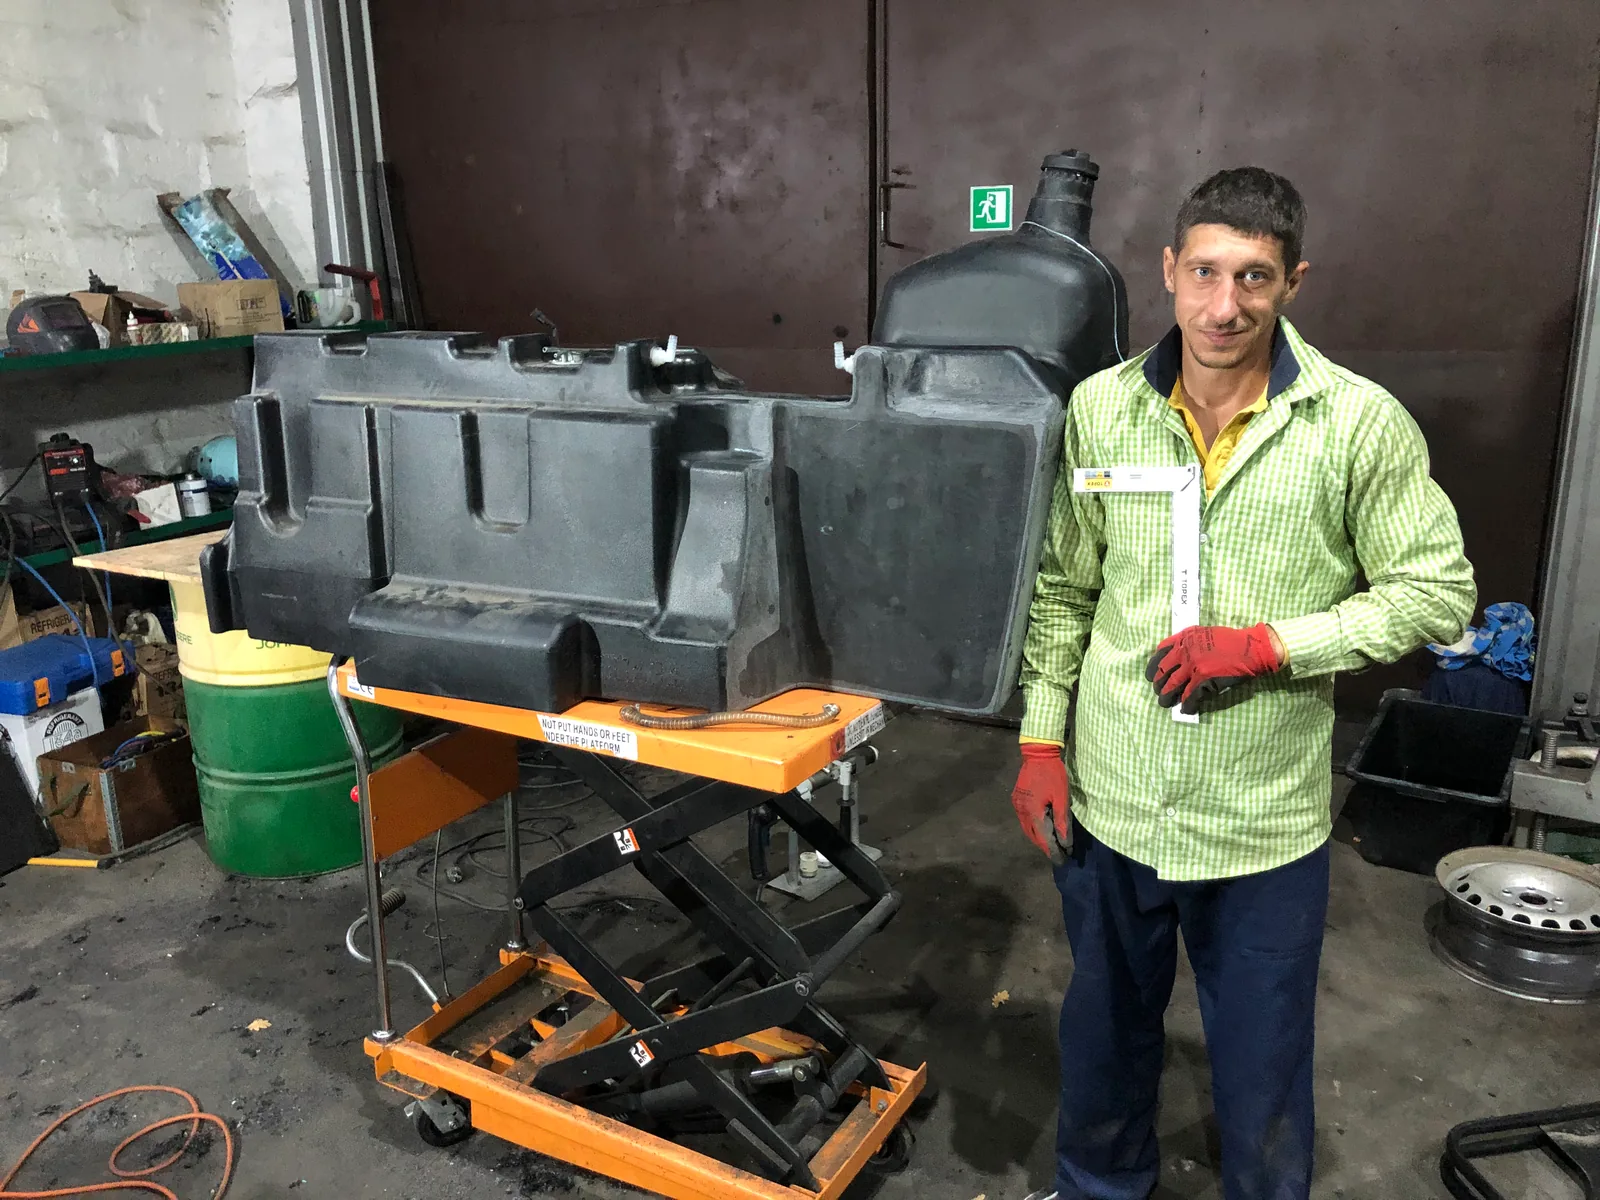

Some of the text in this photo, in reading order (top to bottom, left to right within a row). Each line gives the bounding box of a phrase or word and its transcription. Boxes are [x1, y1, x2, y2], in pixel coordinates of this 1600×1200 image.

[30, 613, 73, 634] REFRIGER
[177, 631, 193, 645] EERE
[558, 721, 571, 732] PUT
[573, 724, 598, 737] HANDS
[600, 729, 610, 740] OR
[612, 731, 630, 743] FEET
